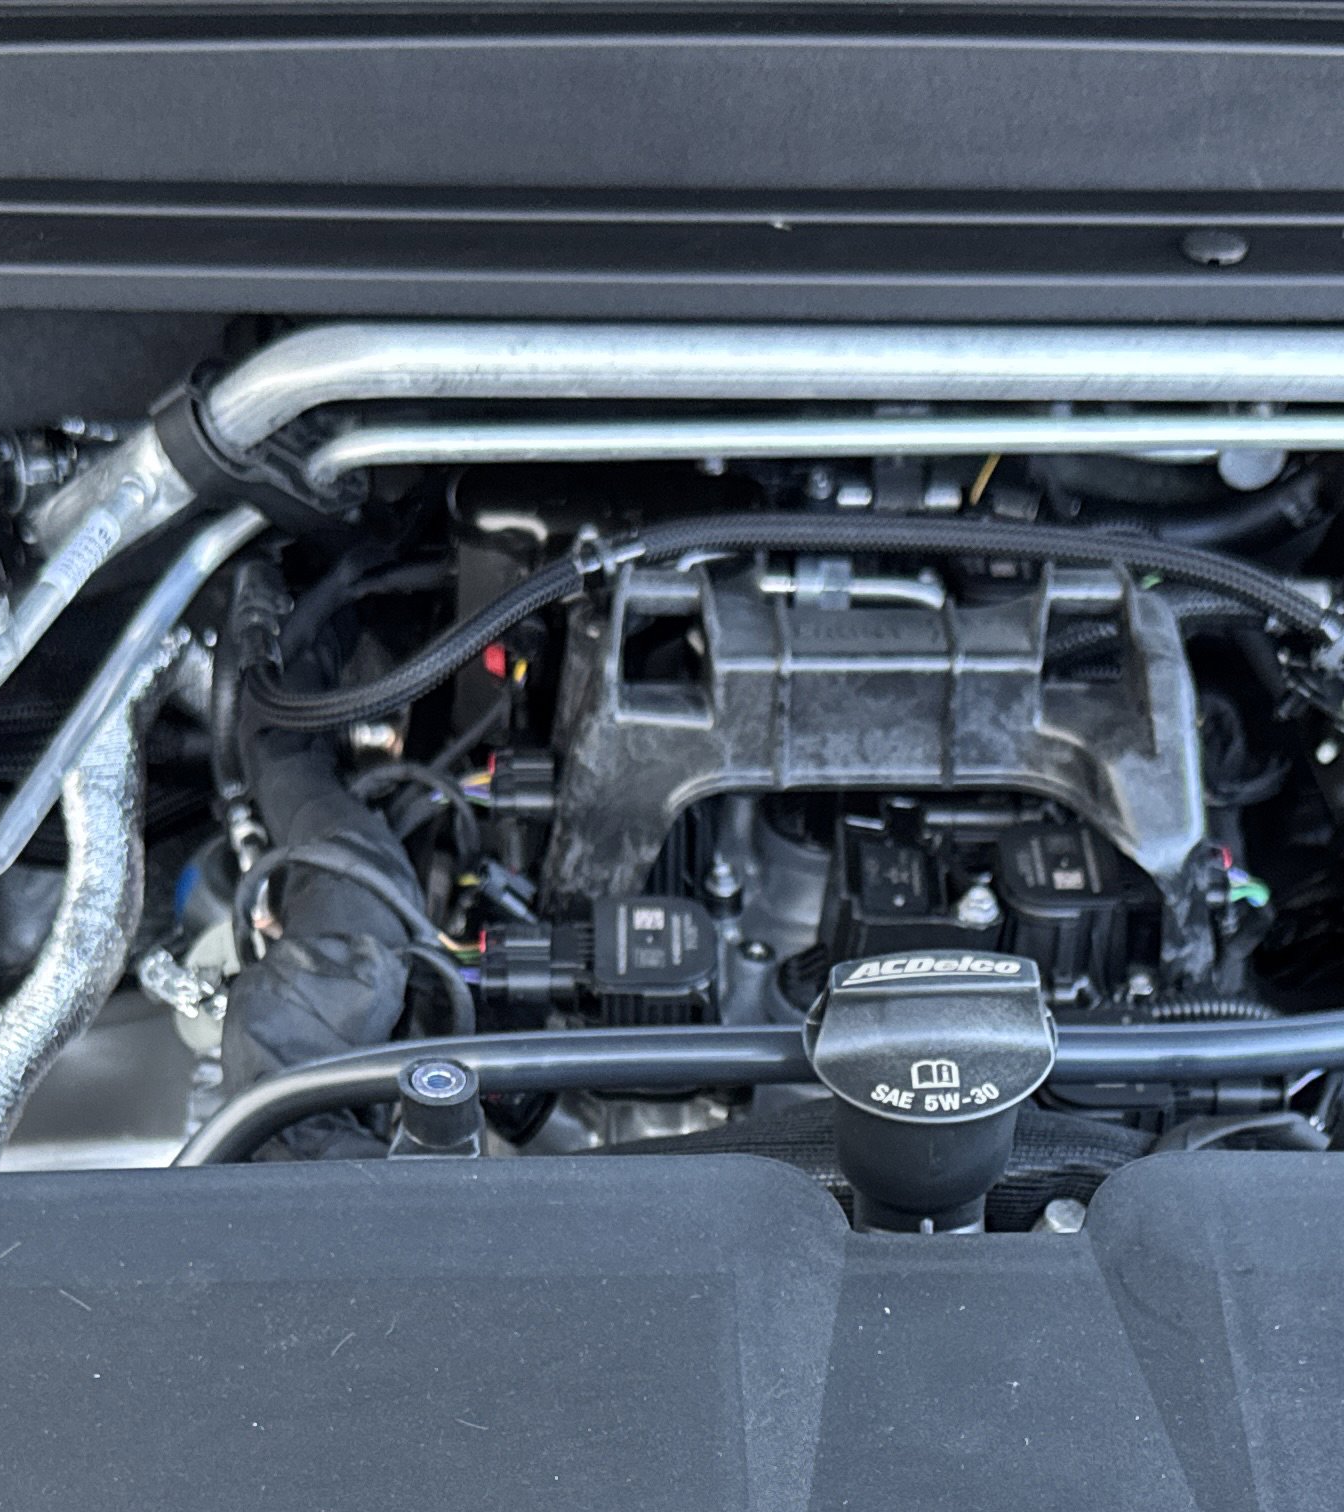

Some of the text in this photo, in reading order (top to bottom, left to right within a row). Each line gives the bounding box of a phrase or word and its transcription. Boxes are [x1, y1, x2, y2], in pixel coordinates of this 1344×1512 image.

[849, 956, 1022, 979] ACDelco
[870, 1083, 1000, 1112] SAE 5W-30
